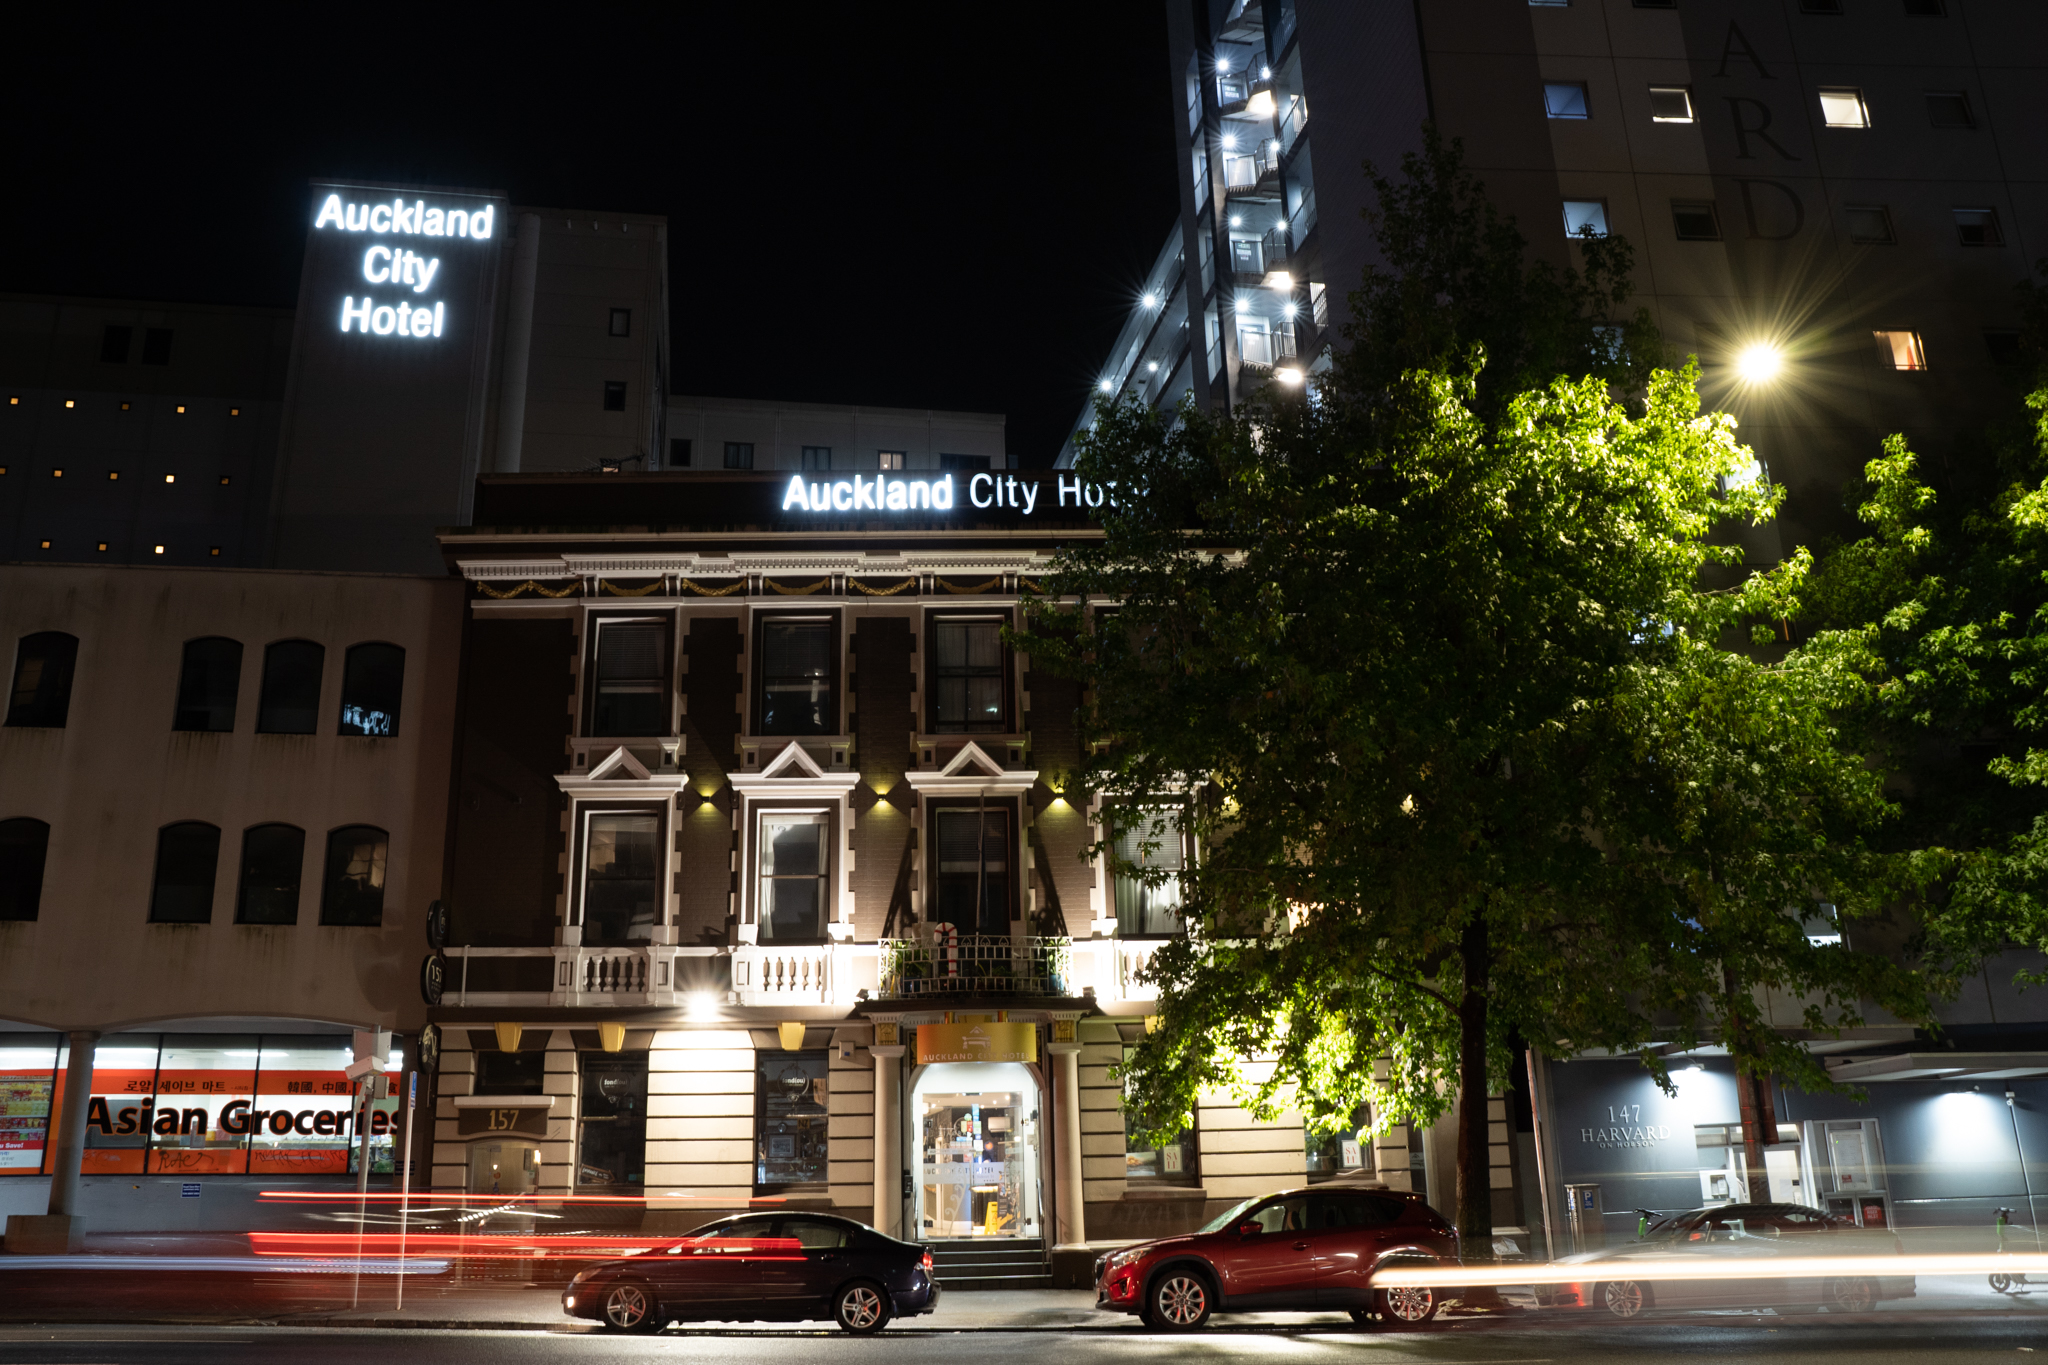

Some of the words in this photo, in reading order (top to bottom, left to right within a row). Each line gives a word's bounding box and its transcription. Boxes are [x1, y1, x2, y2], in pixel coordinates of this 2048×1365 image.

[314, 194, 494, 239] Auckland
[363, 245, 439, 293] City
[340, 296, 444, 338] Hotel
[781, 473, 954, 512] Auckland
[969, 472, 1040, 515] City
[923, 1053, 974, 1061] AUCKLAND
[1002, 1052, 1030, 1060] HOTEL
[159, 1080, 196, 1093] 세이브
[202, 1080, 226, 1093] 마트
[85, 1096, 208, 1136] Asian
[488, 1109, 520, 1130] 157
[1607, 1104, 1641, 1124] 147
[1580, 1125, 1671, 1143] HARVARD
[1617, 1140, 1655, 1149] HOBSON
